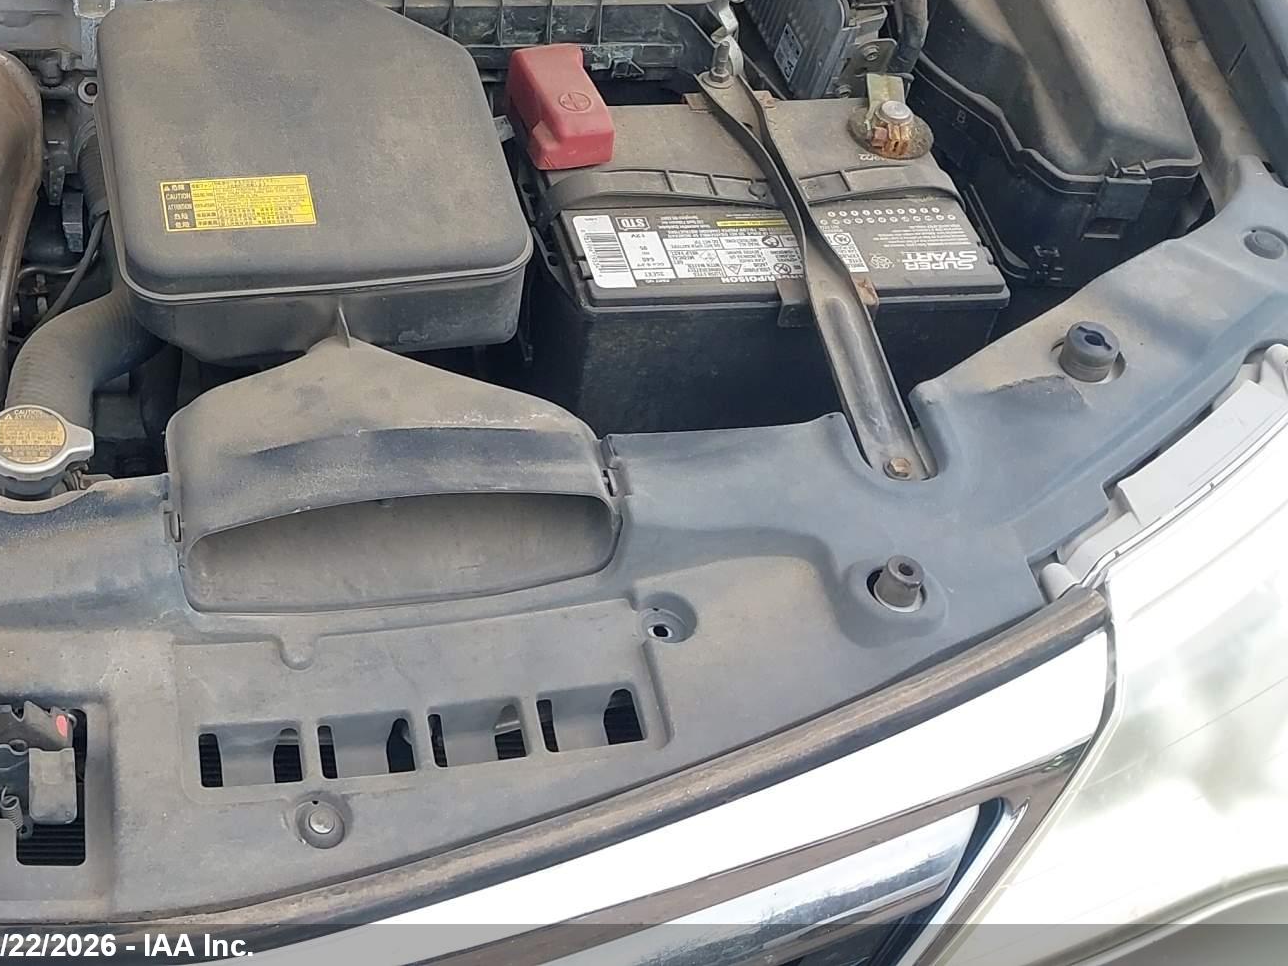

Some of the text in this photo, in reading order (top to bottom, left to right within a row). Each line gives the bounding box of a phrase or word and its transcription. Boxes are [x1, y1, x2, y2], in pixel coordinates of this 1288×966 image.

[620, 218, 645, 228] STD
[902, 250, 978, 262] START
[904, 260, 974, 271] SUPER
